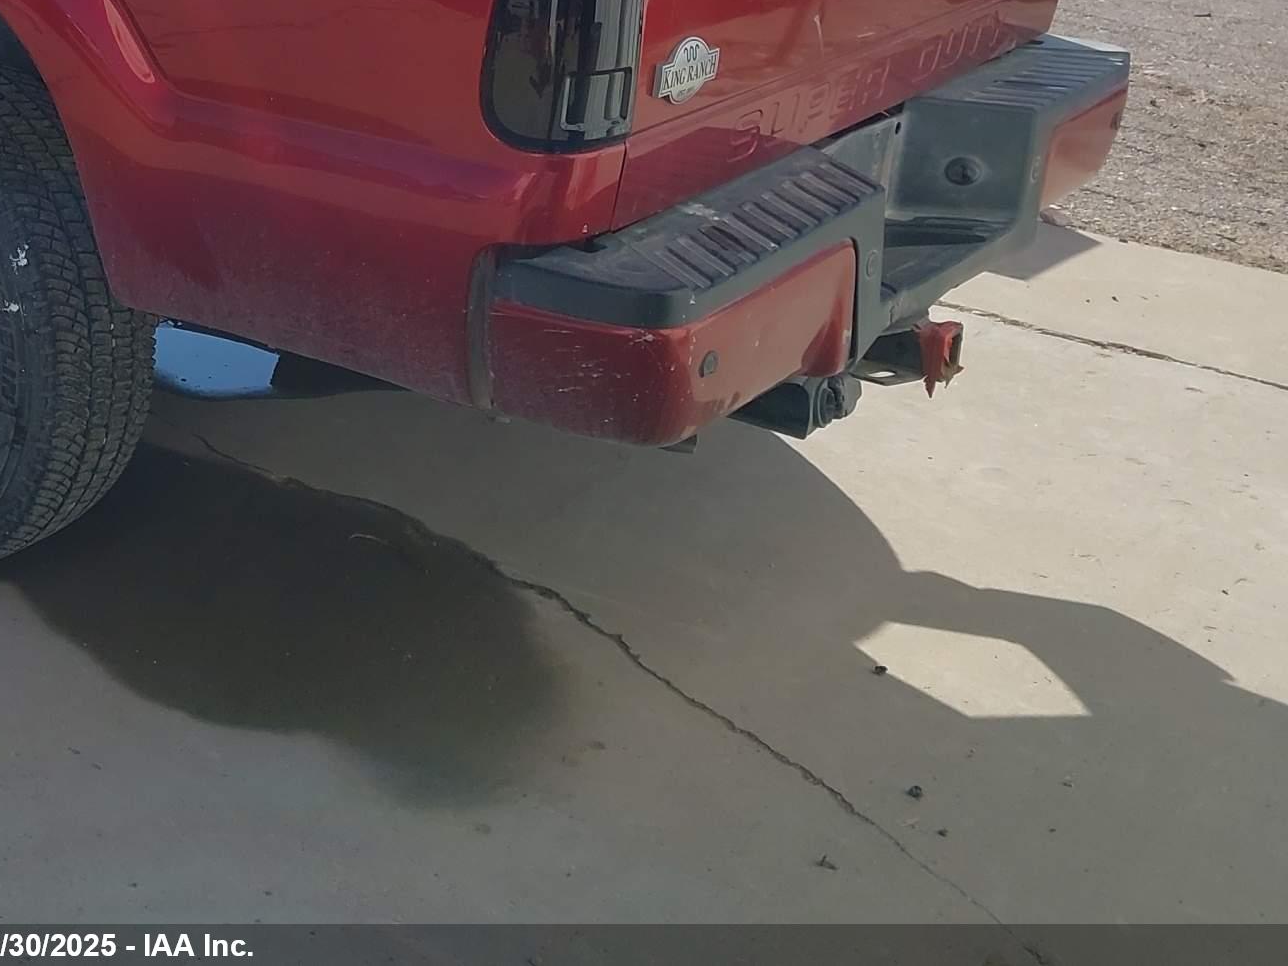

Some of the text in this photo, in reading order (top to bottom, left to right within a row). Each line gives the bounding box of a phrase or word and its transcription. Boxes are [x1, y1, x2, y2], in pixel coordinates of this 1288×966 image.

[664, 55, 717, 90] KING RANCH
[727, 10, 1005, 162] SUPER DUTY
